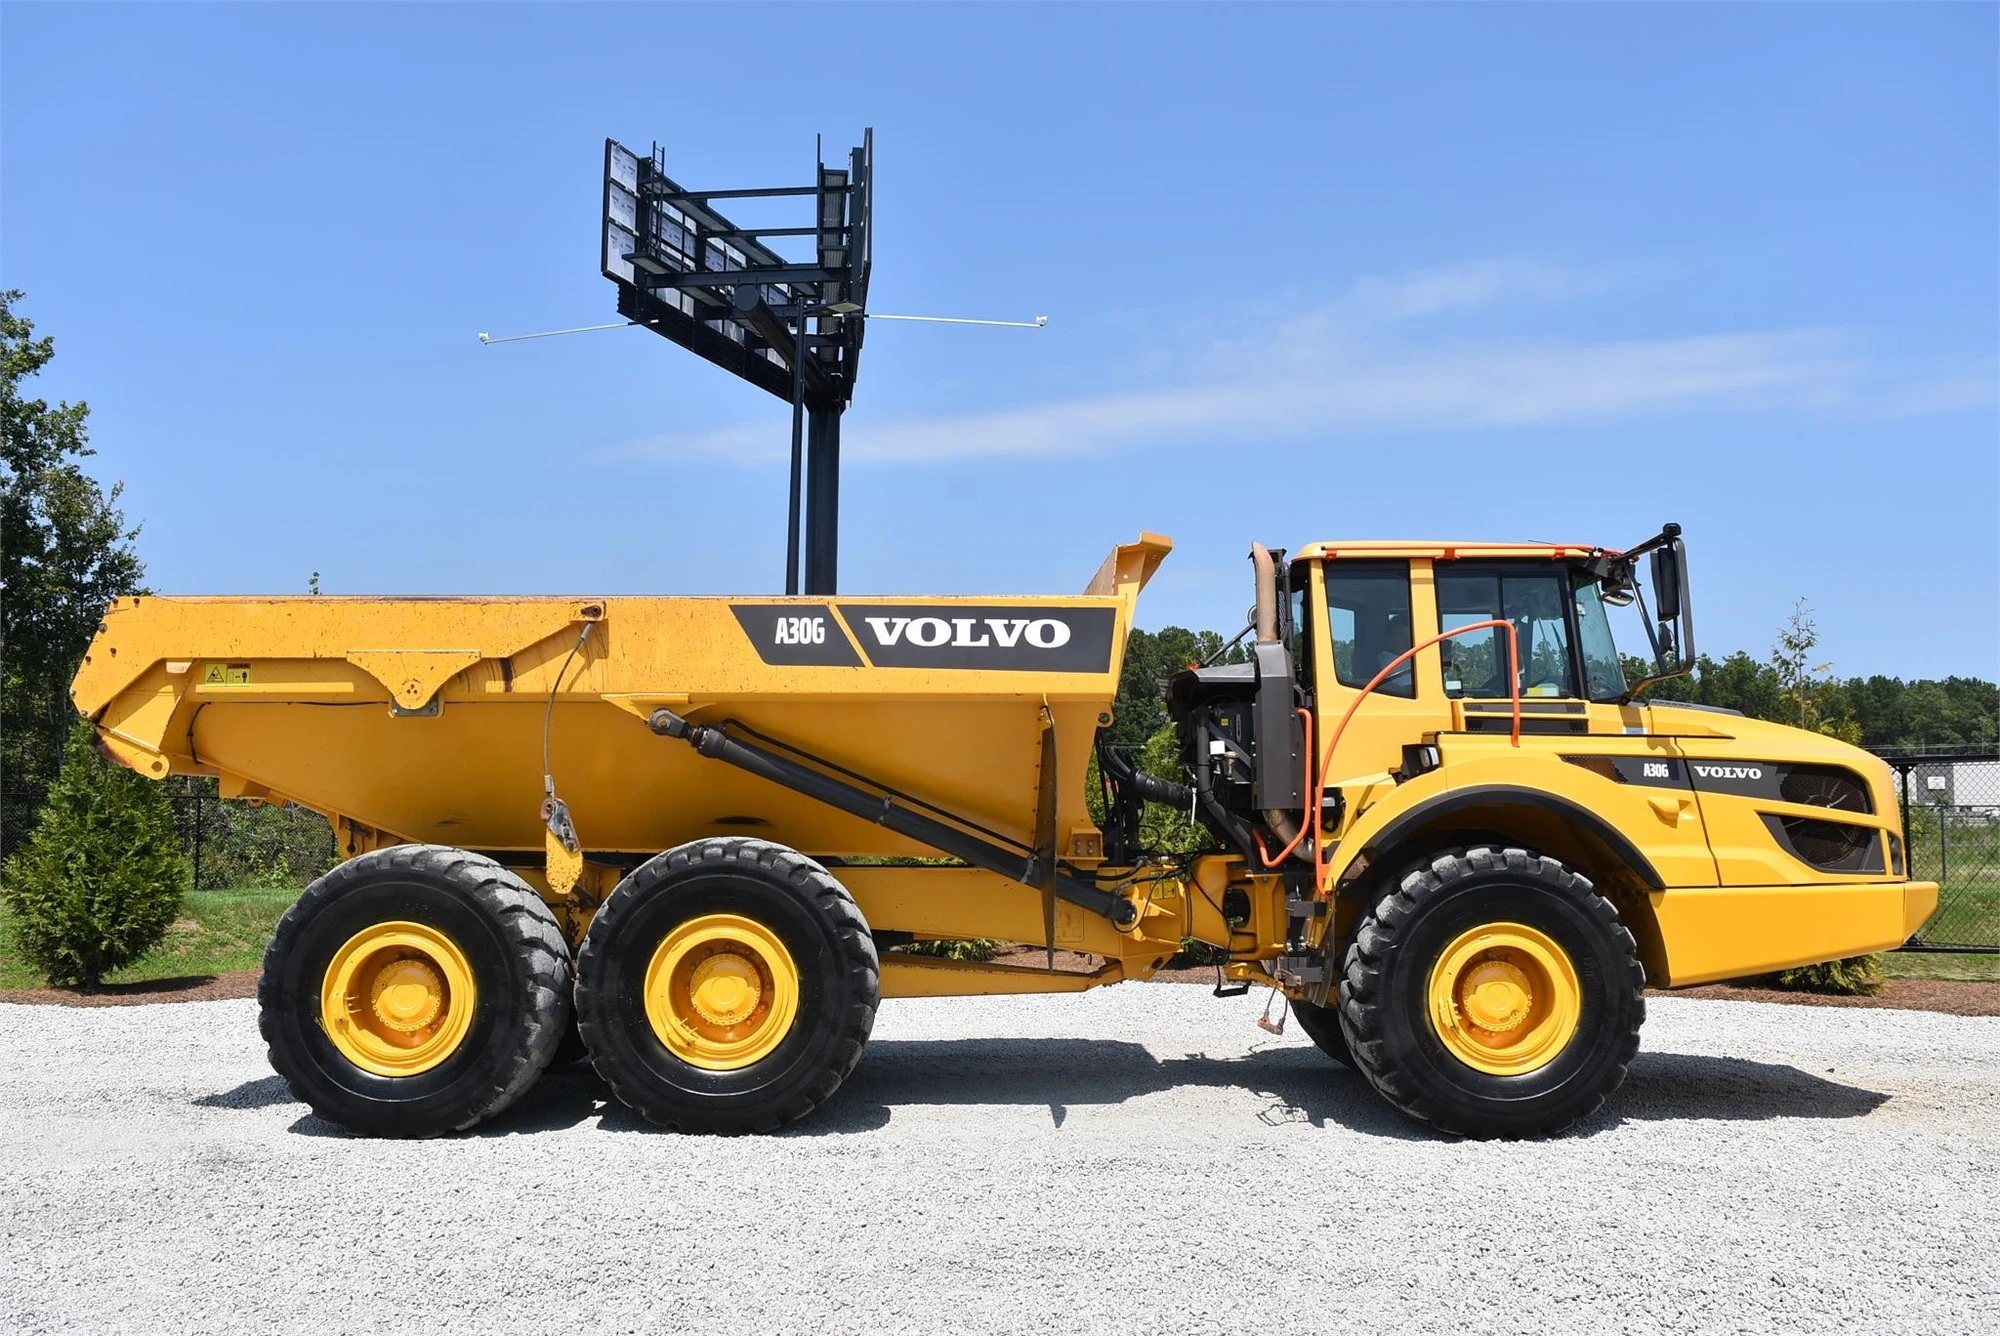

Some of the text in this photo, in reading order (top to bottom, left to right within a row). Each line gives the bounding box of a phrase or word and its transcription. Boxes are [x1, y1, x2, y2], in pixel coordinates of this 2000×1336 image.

[775, 617, 825, 644] A30G
[865, 617, 1071, 649] VOLVO
[1643, 763, 1669, 777] A30G
[1694, 766, 1762, 780] VOLVO
